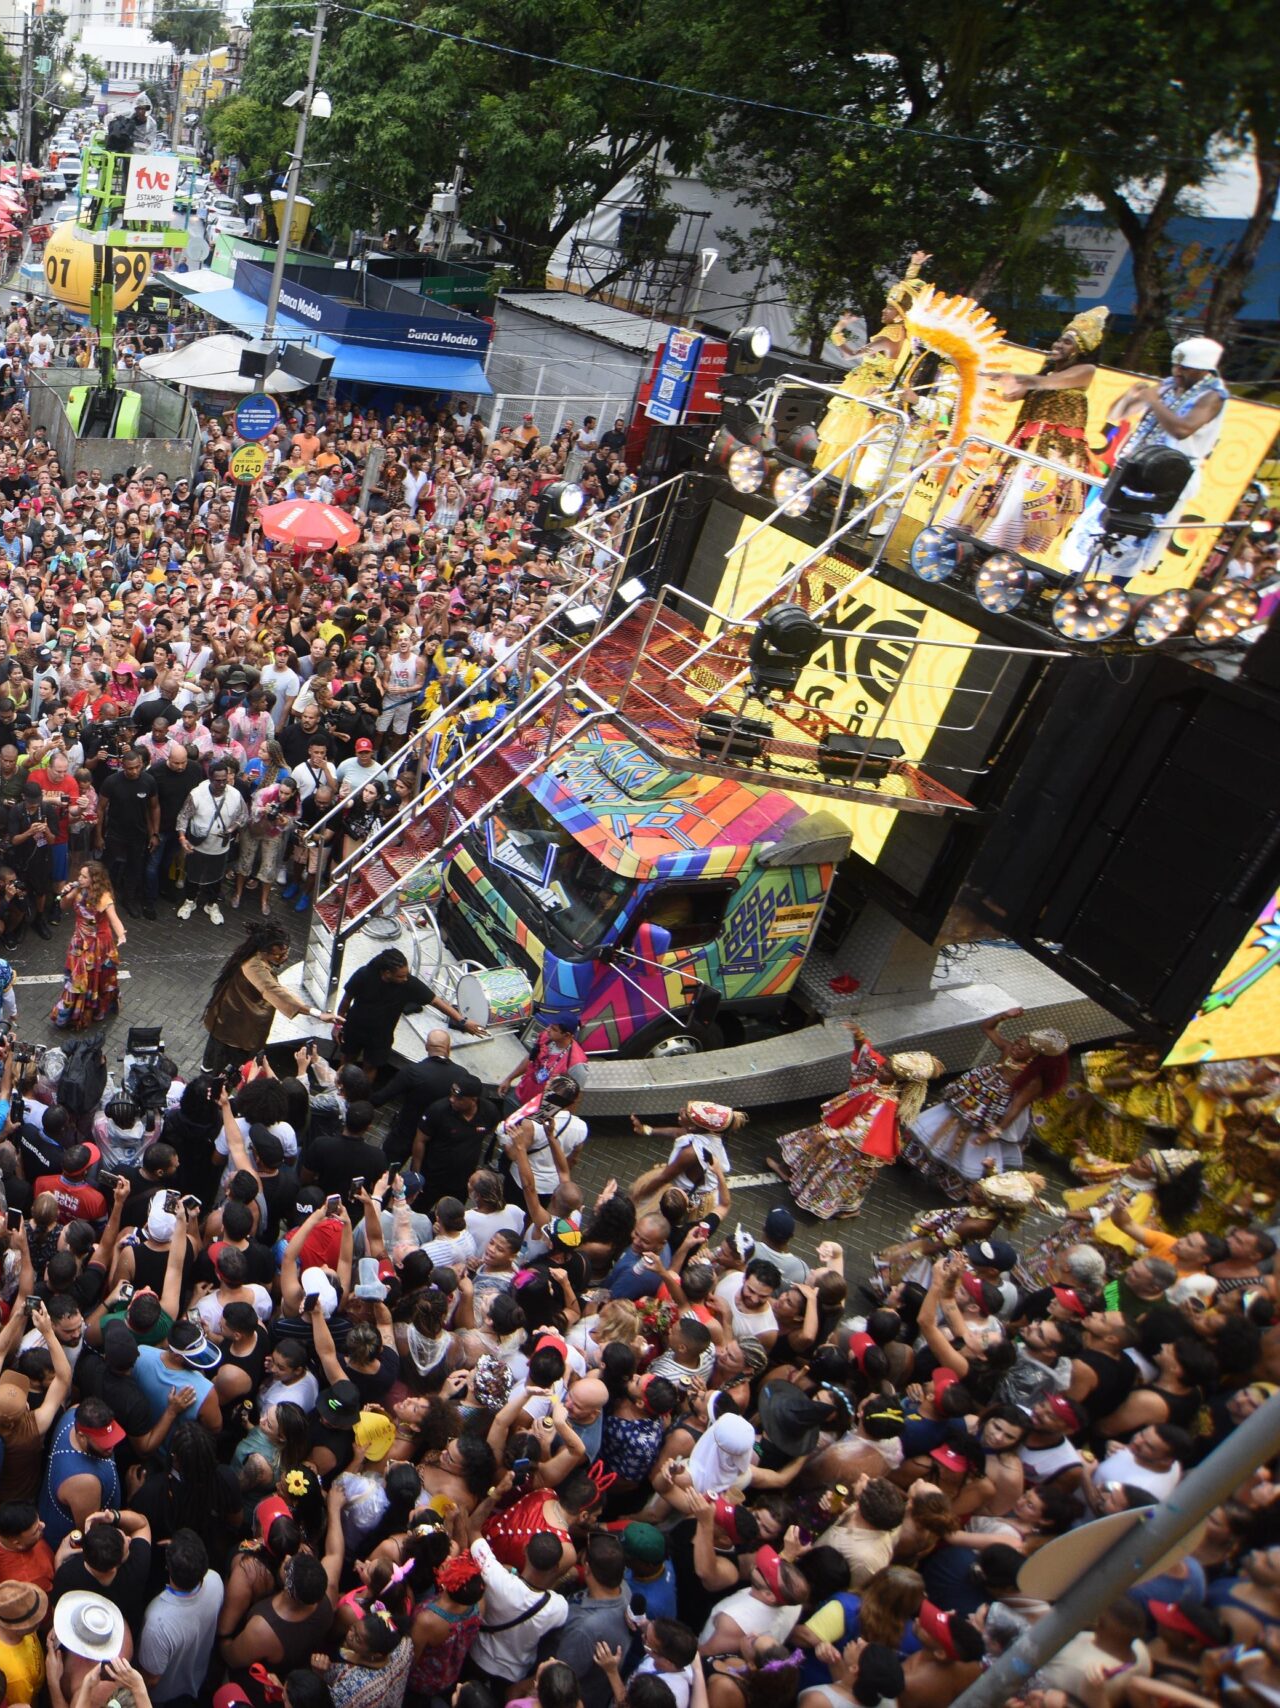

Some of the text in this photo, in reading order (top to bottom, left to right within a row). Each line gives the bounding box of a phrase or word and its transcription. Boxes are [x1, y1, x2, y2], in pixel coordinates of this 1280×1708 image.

[136, 166, 170, 191] tve
[136, 193, 164, 202] ESTAMOS
[46, 255, 71, 288] 01
[278, 288, 322, 322] Banca Modelo
[408, 328, 479, 347] Banca Modelo
[234, 464, 262, 473] 014-D
[20, 1135, 51, 1168] TECNOLOGIA
[296, 1202, 313, 1214] EVA
